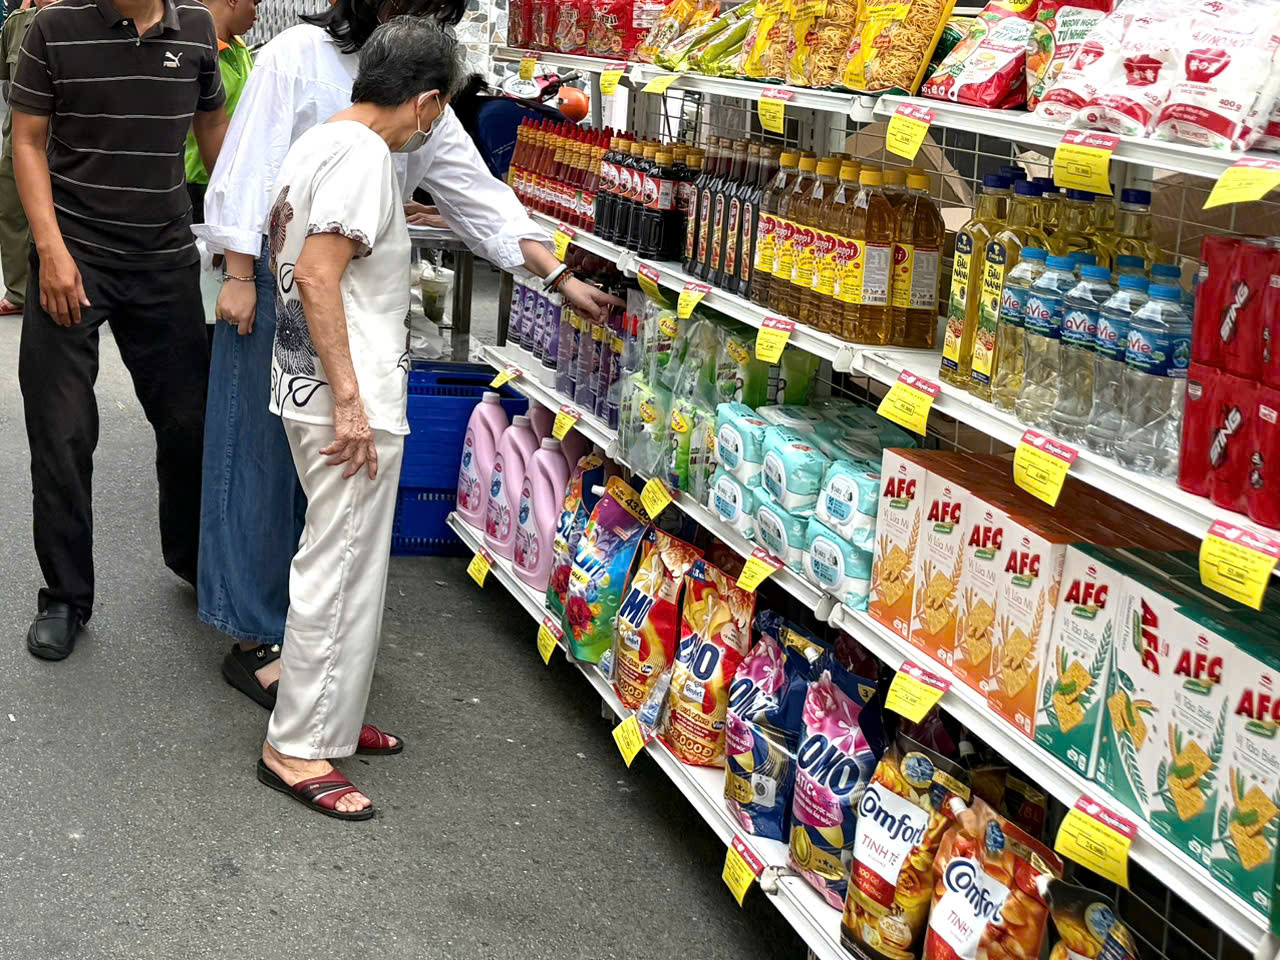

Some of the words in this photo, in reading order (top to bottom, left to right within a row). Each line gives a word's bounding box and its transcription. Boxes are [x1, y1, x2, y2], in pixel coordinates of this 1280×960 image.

[953, 267, 969, 281] NÀNH
[984, 279, 1002, 292] NÀNH
[1221, 281, 1249, 342] STING
[883, 477, 917, 500] AFC
[927, 500, 962, 524] AFC
[968, 524, 1004, 551] AFC
[1004, 550, 1041, 578] AFC
[1064, 579, 1109, 609] AFC
[1141, 596, 1160, 676] AFC
[1174, 648, 1224, 685] AFC
[797, 732, 861, 797] OMO
[859, 786, 927, 844] Comfort
[862, 833, 889, 858] TINH
